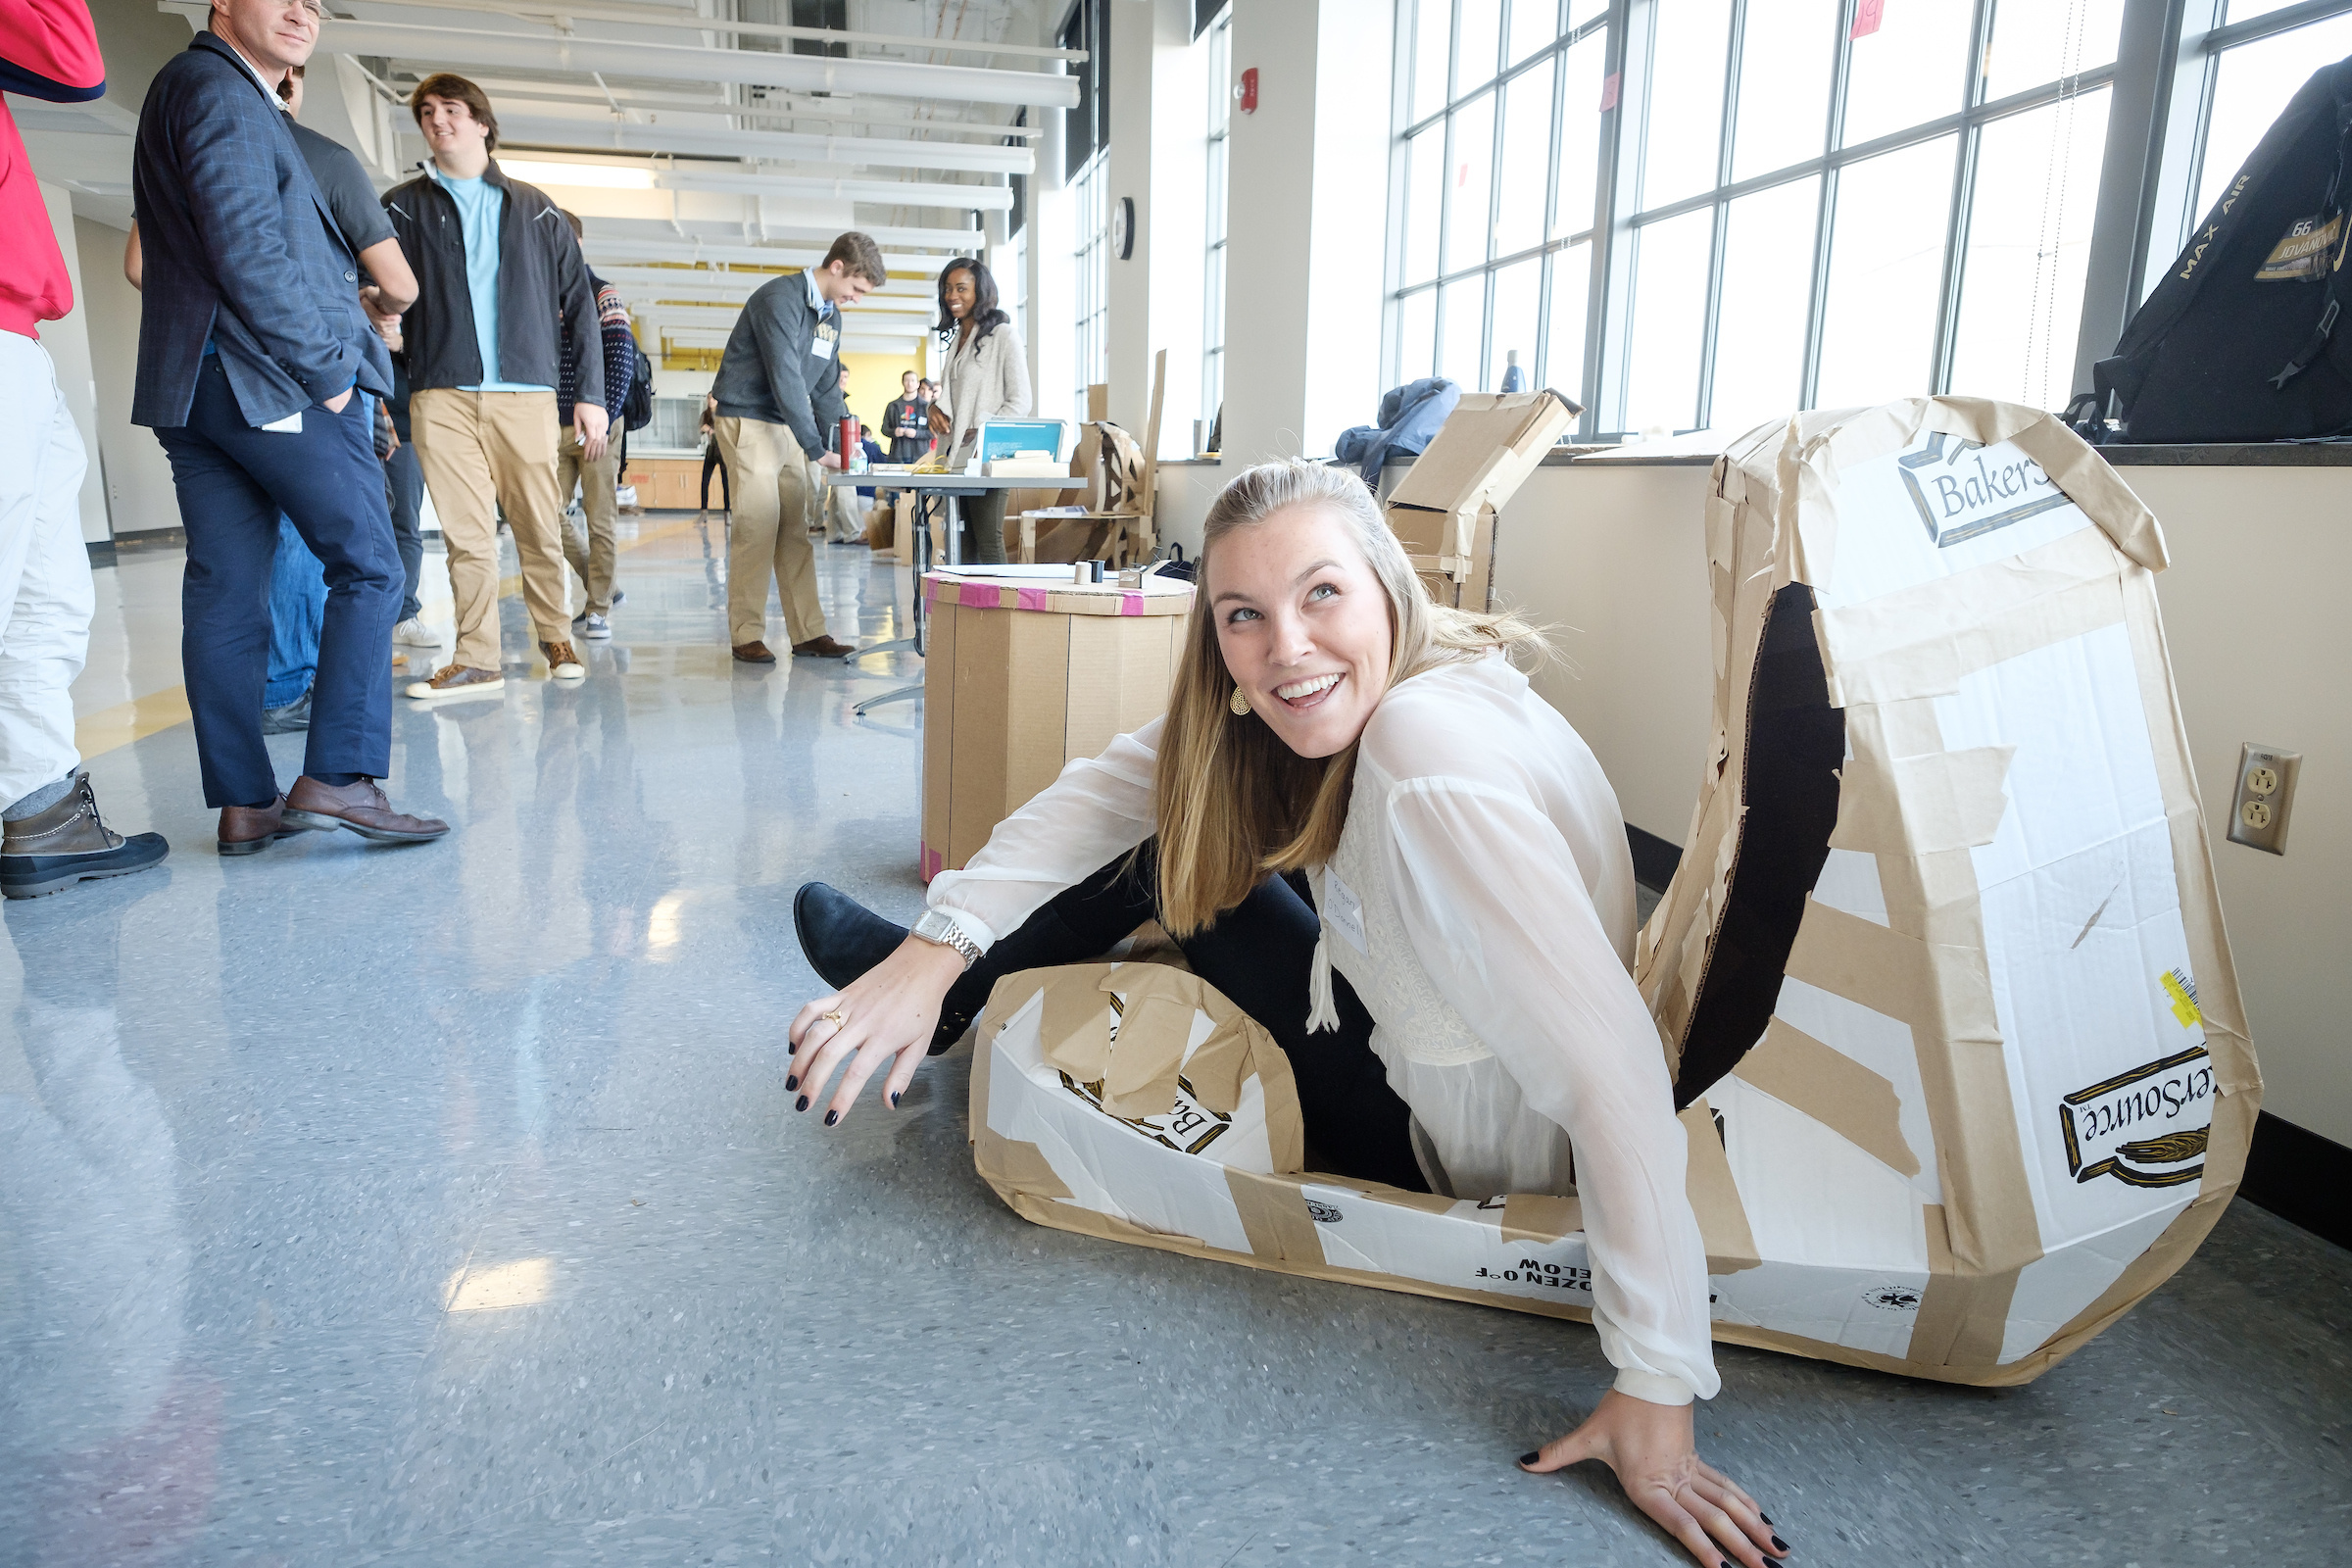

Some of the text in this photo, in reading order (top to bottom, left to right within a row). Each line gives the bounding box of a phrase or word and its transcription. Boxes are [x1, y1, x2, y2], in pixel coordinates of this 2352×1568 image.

[2180, 174, 2251, 280] MAX AIR
[2291, 220, 2313, 237] 66
[2082, 1065, 2219, 1142] erSource
[1518, 1258, 1592, 1279] ELOW
[1526, 1271, 1592, 1292] OZEN
